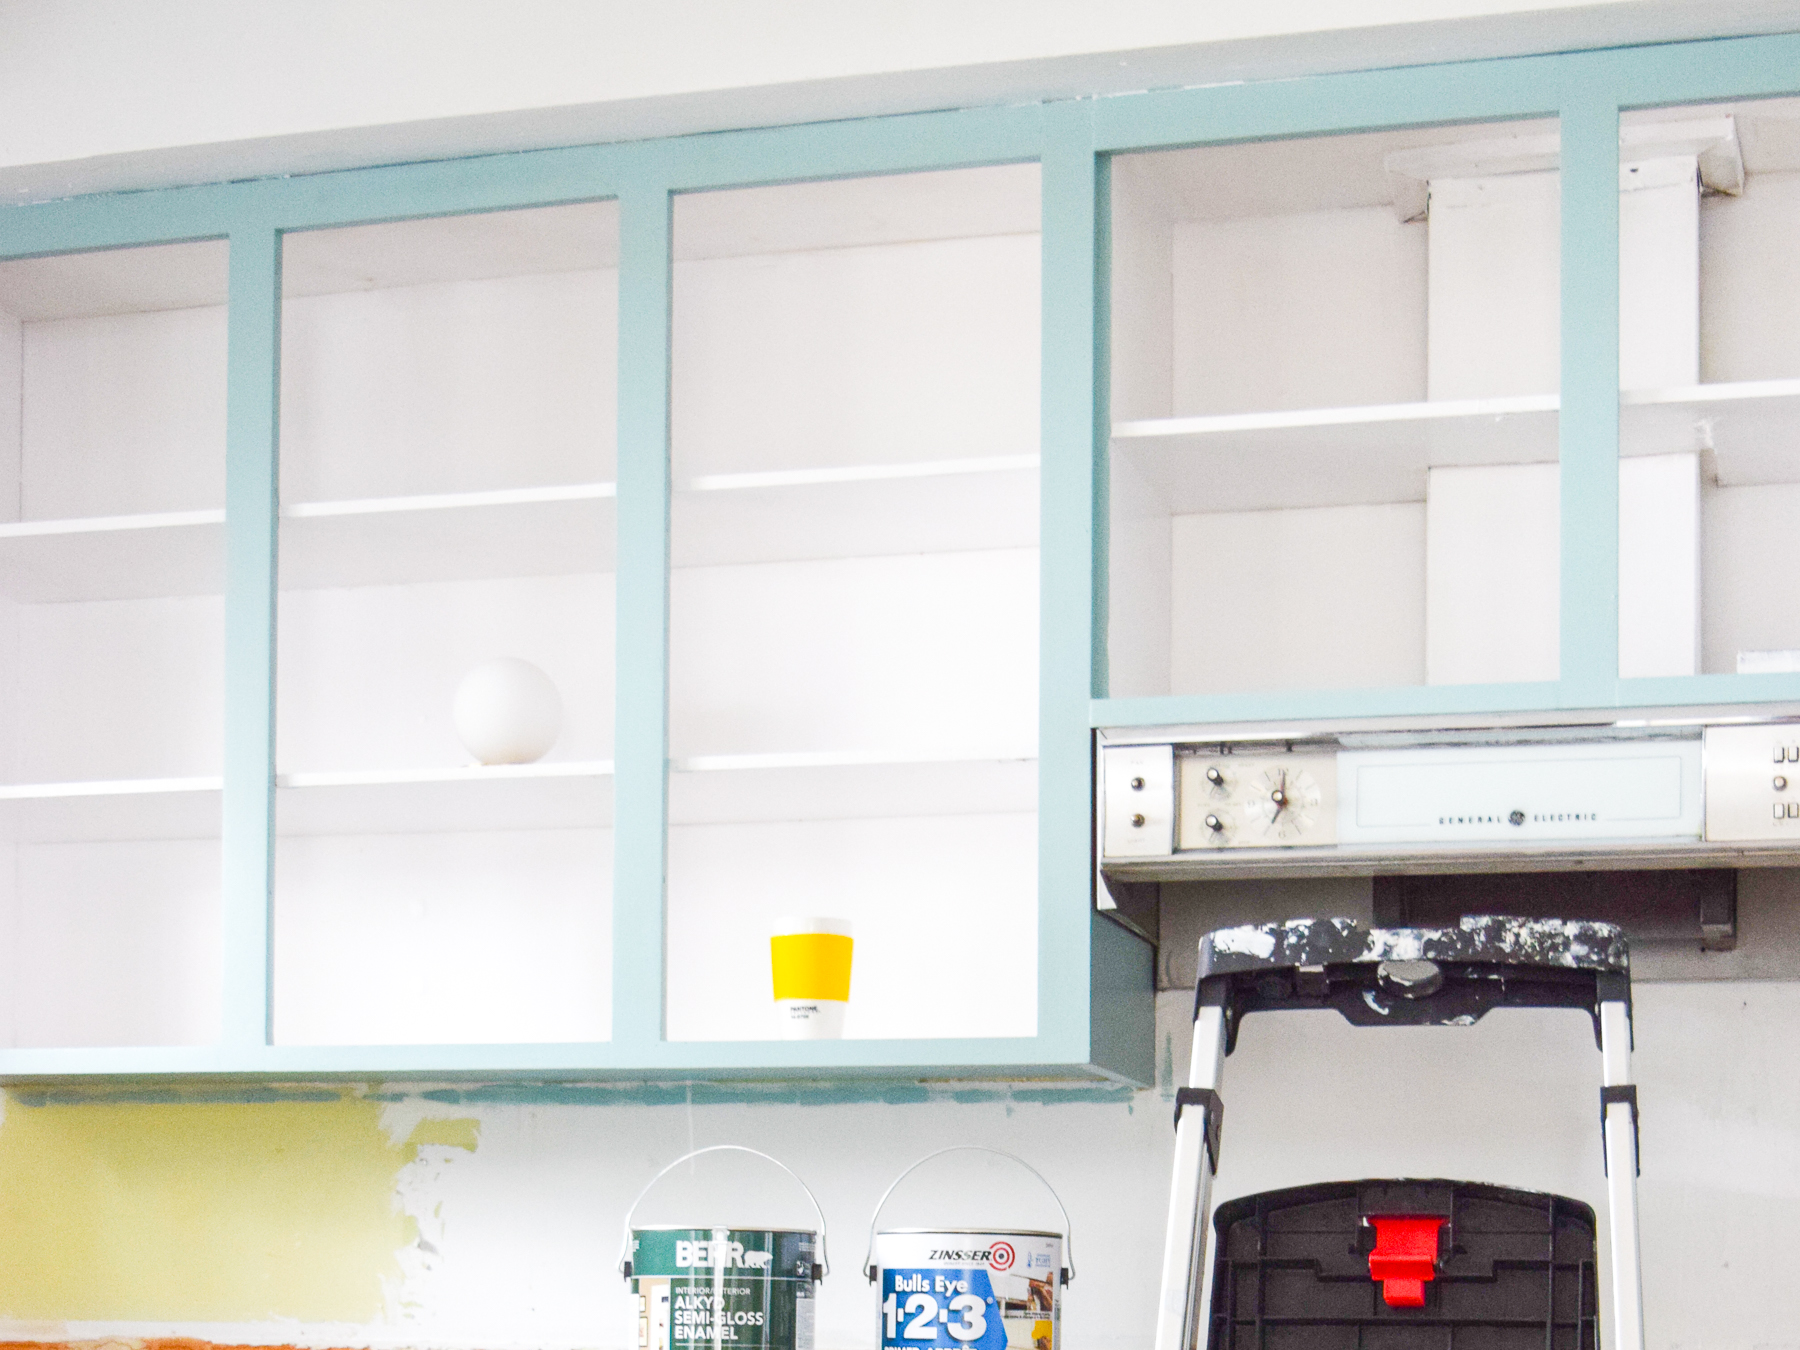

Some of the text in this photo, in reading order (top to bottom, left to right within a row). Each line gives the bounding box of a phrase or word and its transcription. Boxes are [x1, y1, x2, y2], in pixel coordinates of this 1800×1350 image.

[1438, 813, 1597, 825] GENERAL ELECTRIC
[928, 1250, 992, 1261] ZINSSER
[675, 1286, 751, 1296] INTERIOR/TERIOR
[894, 1274, 968, 1297] Bulls Eye
[674, 1295, 726, 1310] ALKYD
[674, 1310, 764, 1326] SEMI-GLOSS
[674, 1325, 739, 1340] ENAMEL
